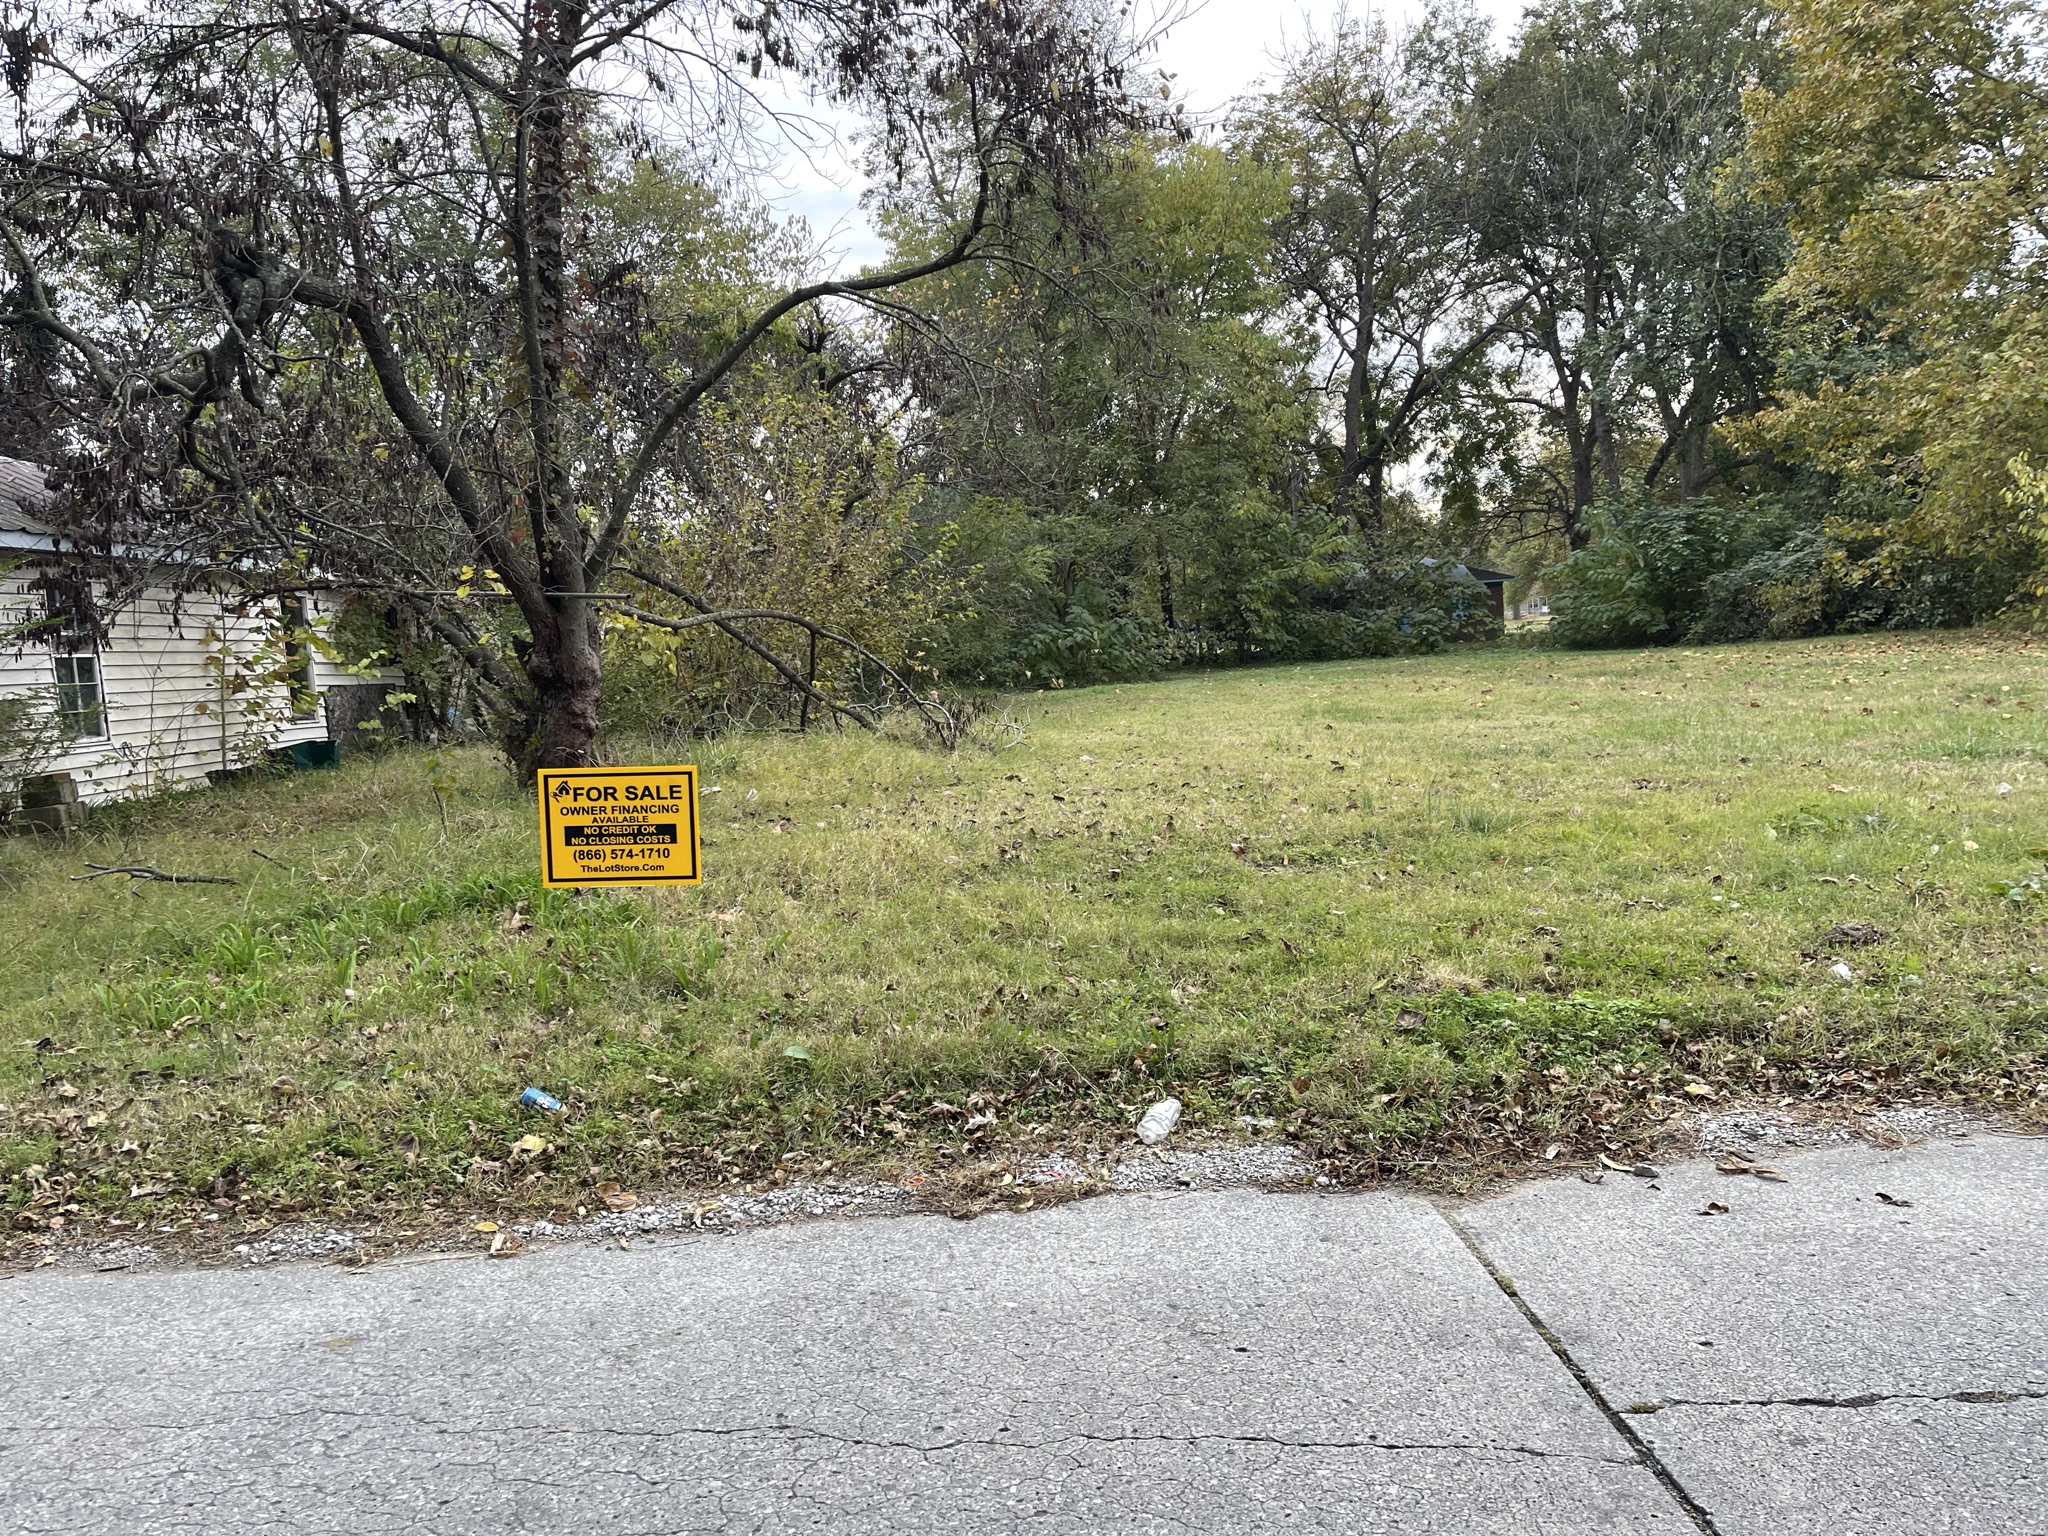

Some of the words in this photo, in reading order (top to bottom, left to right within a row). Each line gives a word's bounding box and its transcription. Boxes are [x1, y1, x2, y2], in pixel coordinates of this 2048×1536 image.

[573, 787, 618, 802] FOR
[625, 785, 682, 801] SALE
[560, 807, 607, 815] OWNER
[611, 804, 679, 814] FINANCING
[602, 826, 639, 834] CREDIT
[642, 825, 656, 833] OK
[572, 837, 586, 845] NO
[589, 836, 634, 844] CLOSING
[574, 849, 606, 863] (866)
[611, 848, 670, 859] 574-1710
[581, 864, 664, 872] TheLotStore.Com
